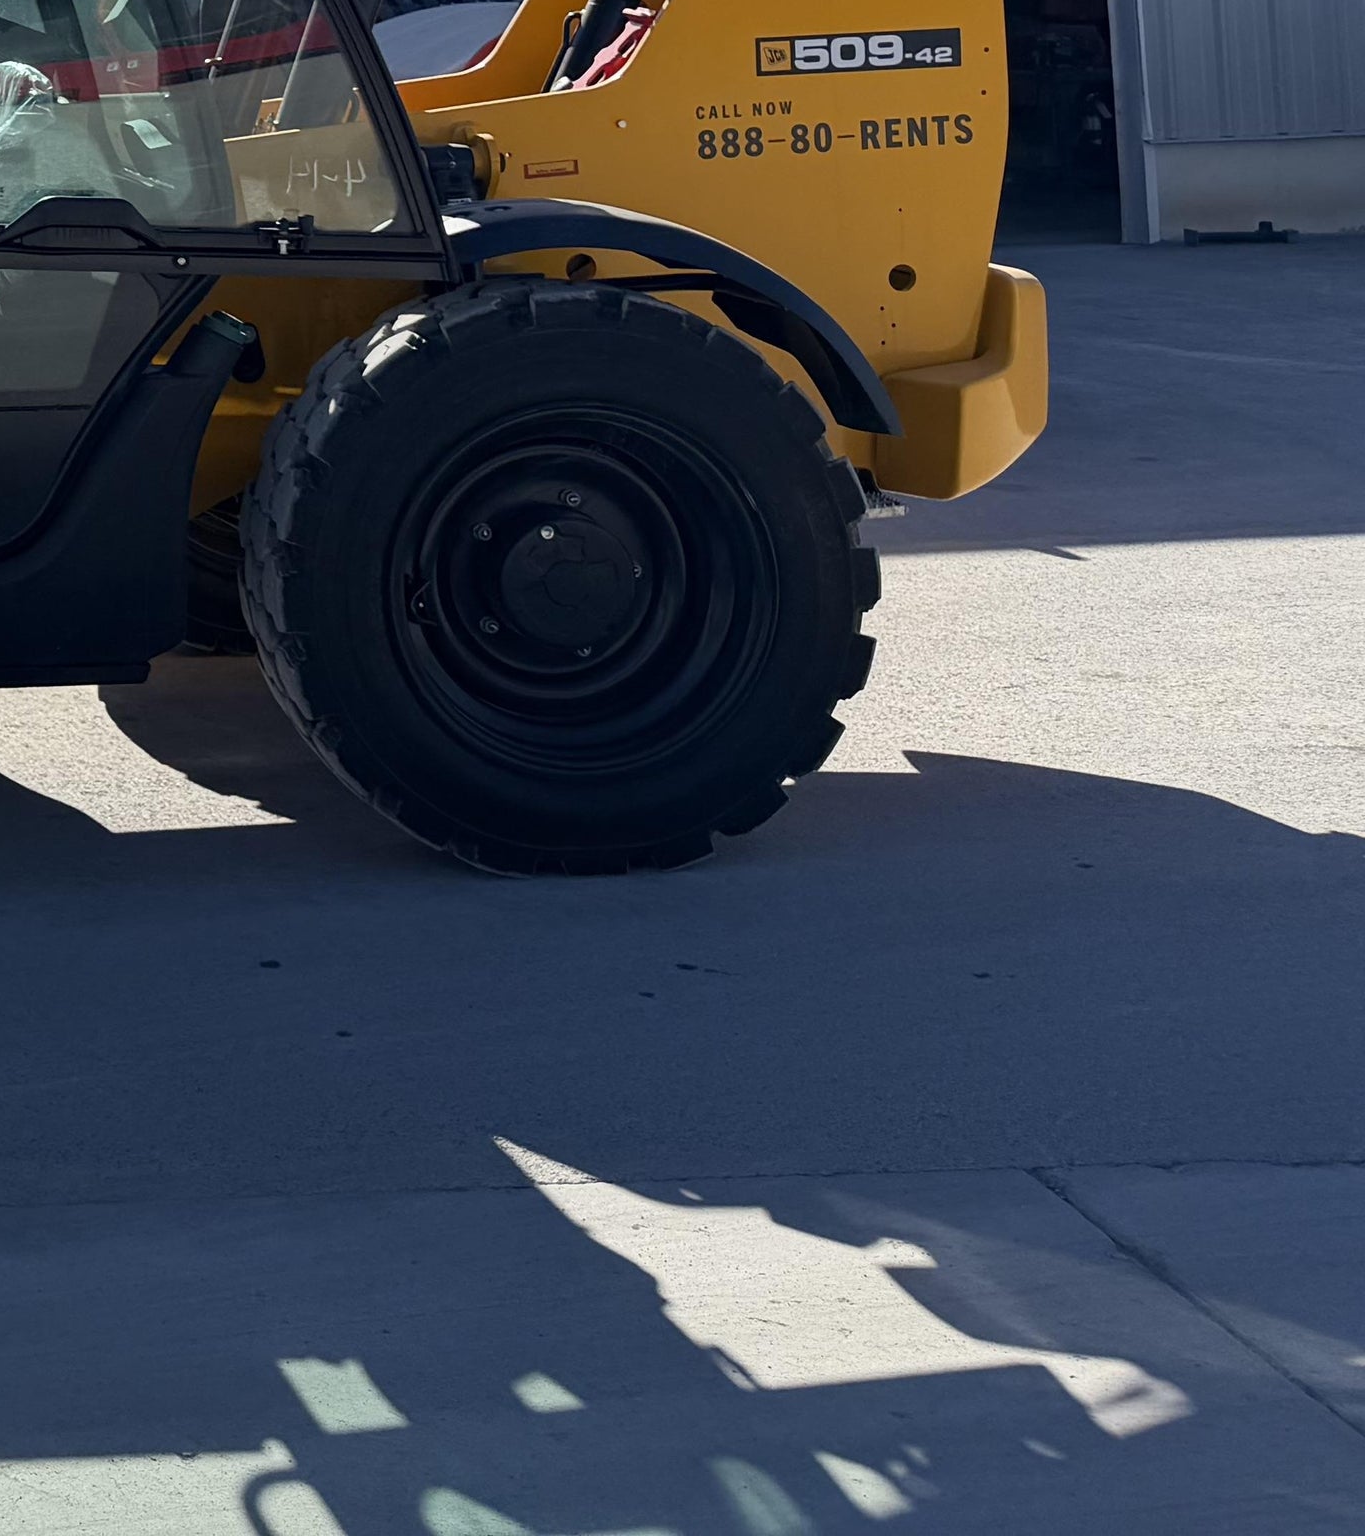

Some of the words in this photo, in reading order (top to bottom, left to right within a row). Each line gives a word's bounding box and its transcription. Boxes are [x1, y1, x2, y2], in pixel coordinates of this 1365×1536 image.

[794, 34, 953, 70] 509-42
[696, 104, 742, 120] CALL
[752, 101, 793, 116] NOW
[697, 114, 973, 160] 888-80-RENTS
